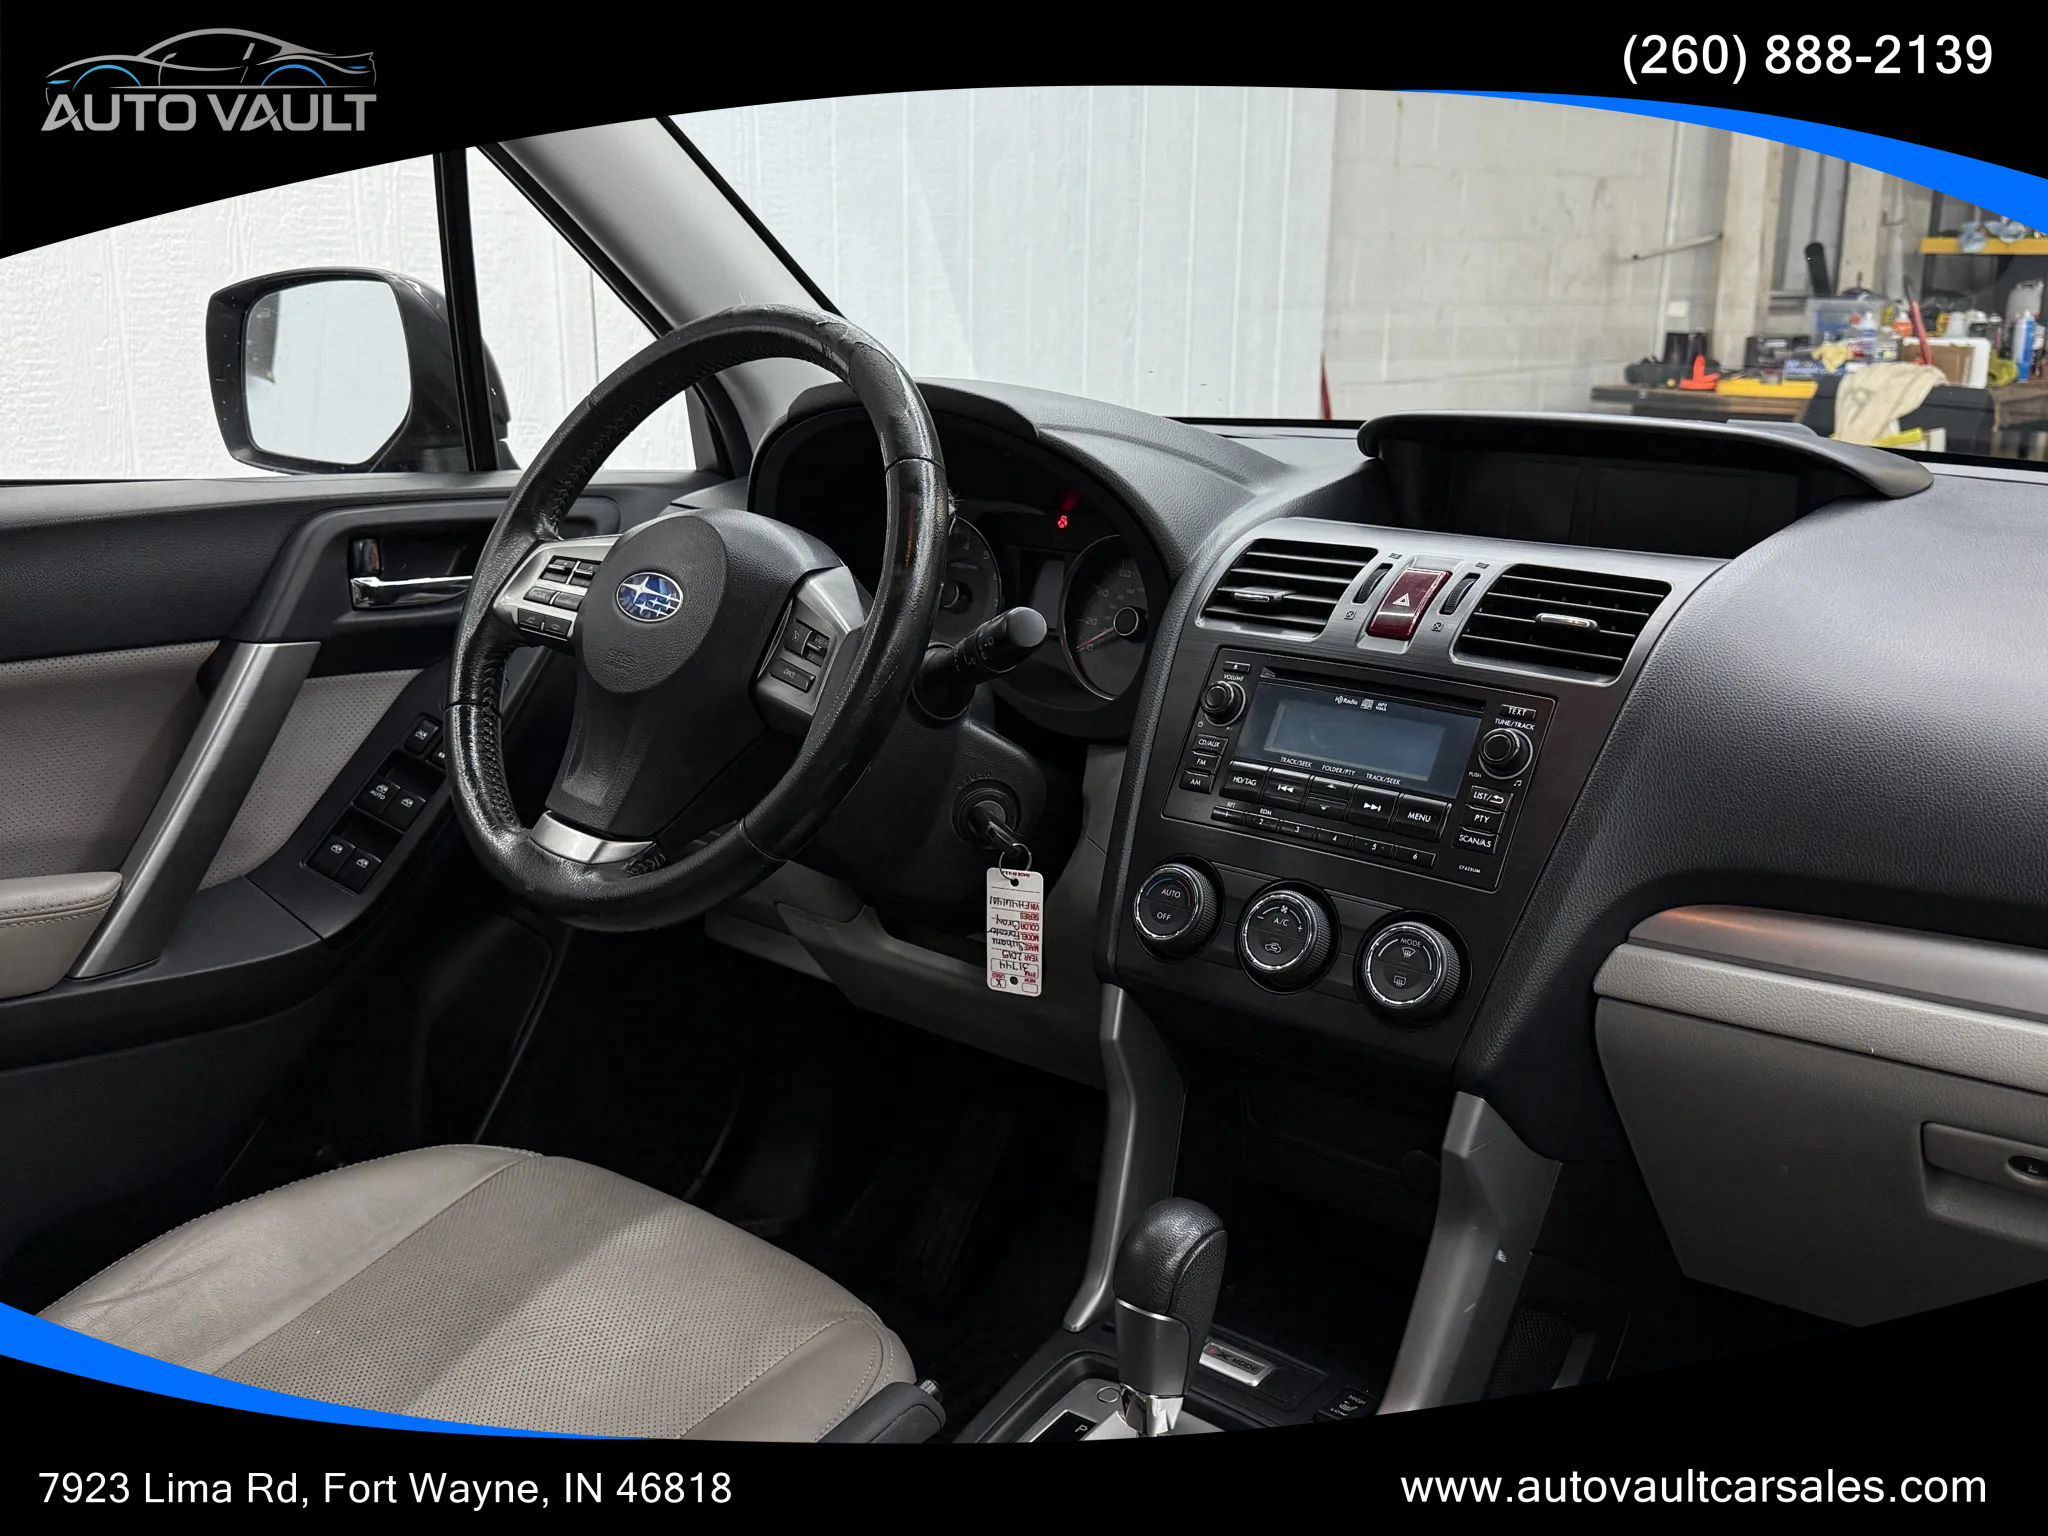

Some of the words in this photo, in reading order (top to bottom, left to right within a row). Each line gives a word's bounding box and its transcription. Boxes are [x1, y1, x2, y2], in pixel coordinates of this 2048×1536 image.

[1223, 673, 1245, 682] VOLUME
[1508, 706, 1527, 717] TEXT
[1494, 717, 1536, 731] TUNE/TRACK
[1198, 738, 1221, 748] CD/AUX
[1196, 758, 1207, 767] FM
[1280, 756, 1313, 769] TRACK/SEEK
[1321, 764, 1356, 777] FOLDER/PTY
[1468, 770, 1482, 779] PUSH
[1189, 778, 1201, 787] AM
[1232, 775, 1257, 787] HD/TAG
[1366, 772, 1401, 786] TRACK/SEEK
[369, 789, 386, 801] AUTO
[1407, 811, 1432, 823] MENU
[1474, 814, 1491, 824] PTY
[1161, 887, 1182, 900] AUTO
[1030, 902, 1040, 911] VIN
[1020, 911, 1040, 922] SERIES
[1156, 911, 1172, 922] OFF
[1272, 916, 1290, 928] A/C
[1020, 921, 1040, 931] COLOR
[1021, 931, 1040, 942] MODEL
[1023, 942, 1040, 952] MAKE
[1400, 936, 1422, 949] MODE
[1024, 953, 1039, 963] YEAR
[1074, 1424, 1088, 1433] P
